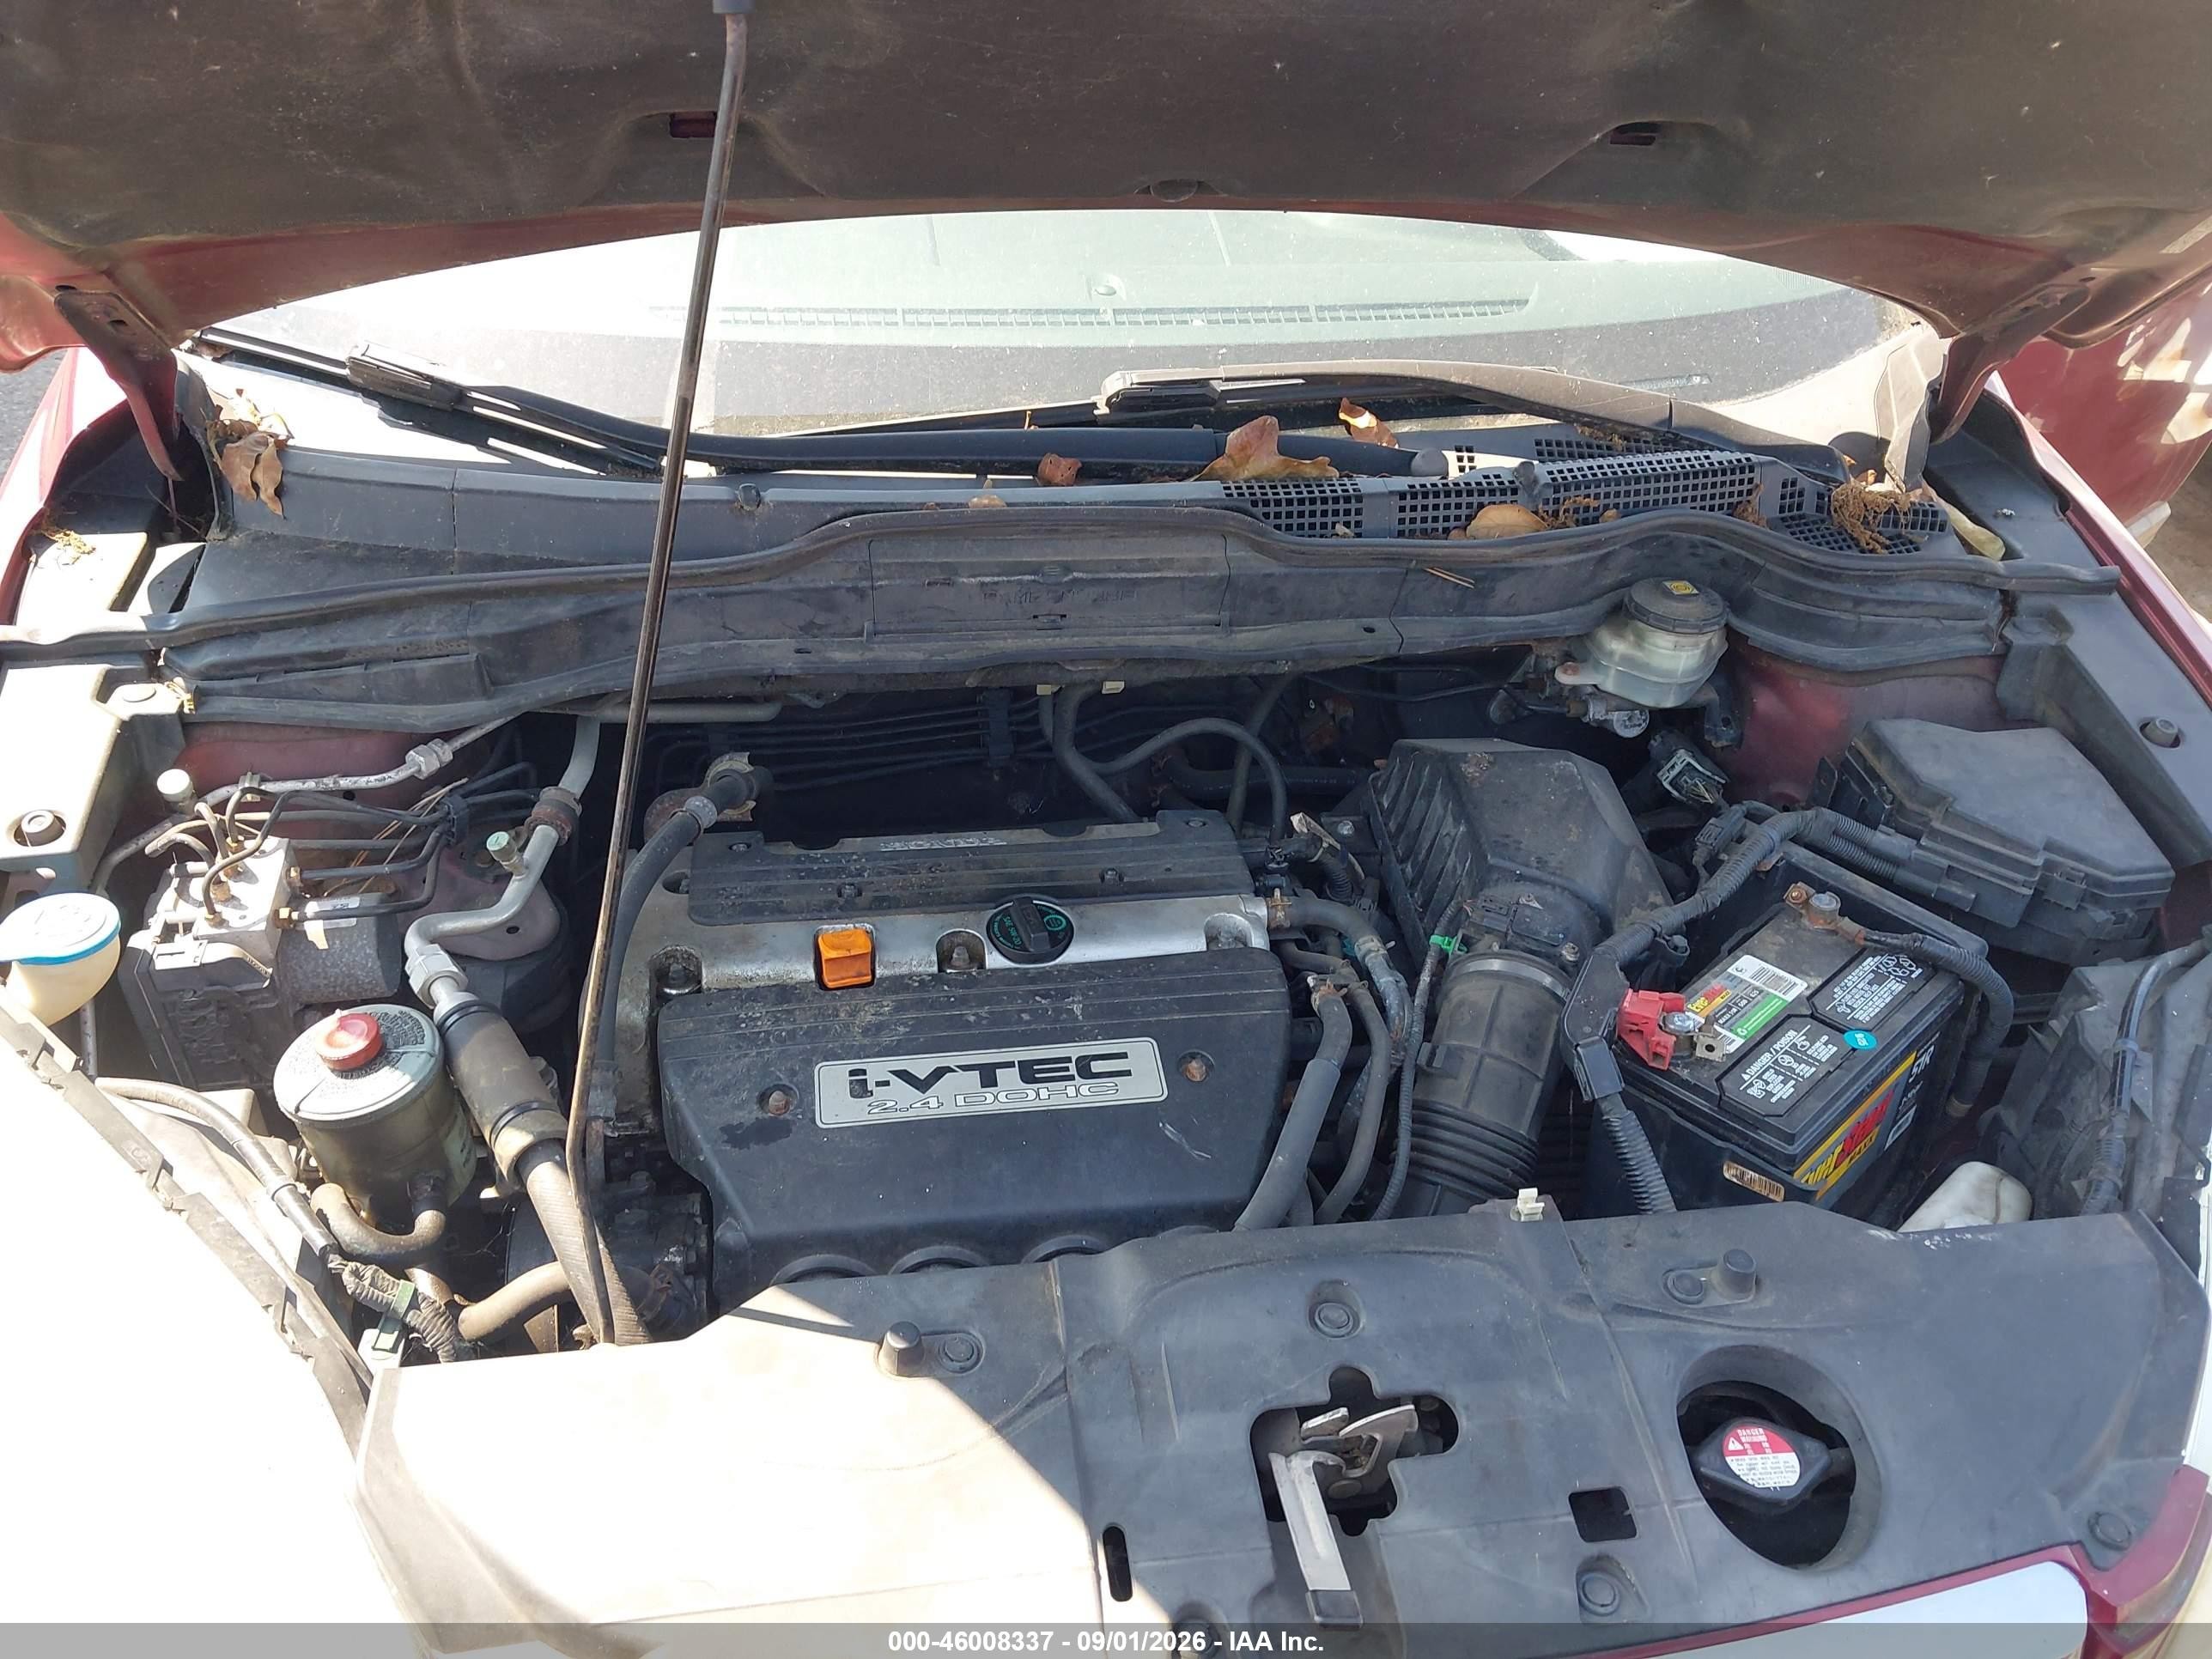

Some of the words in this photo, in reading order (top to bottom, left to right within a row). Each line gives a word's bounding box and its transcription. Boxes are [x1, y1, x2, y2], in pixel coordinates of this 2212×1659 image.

[1746, 1052, 1774, 1077] DANGER
[1775, 1030, 1798, 1052] POISON
[848, 1052, 1133, 1100] i-VTEC
[867, 1095, 944, 1115] 2.4
[954, 1081, 1119, 1108] DOHC
[1737, 1427, 1765, 1437] DANGER
